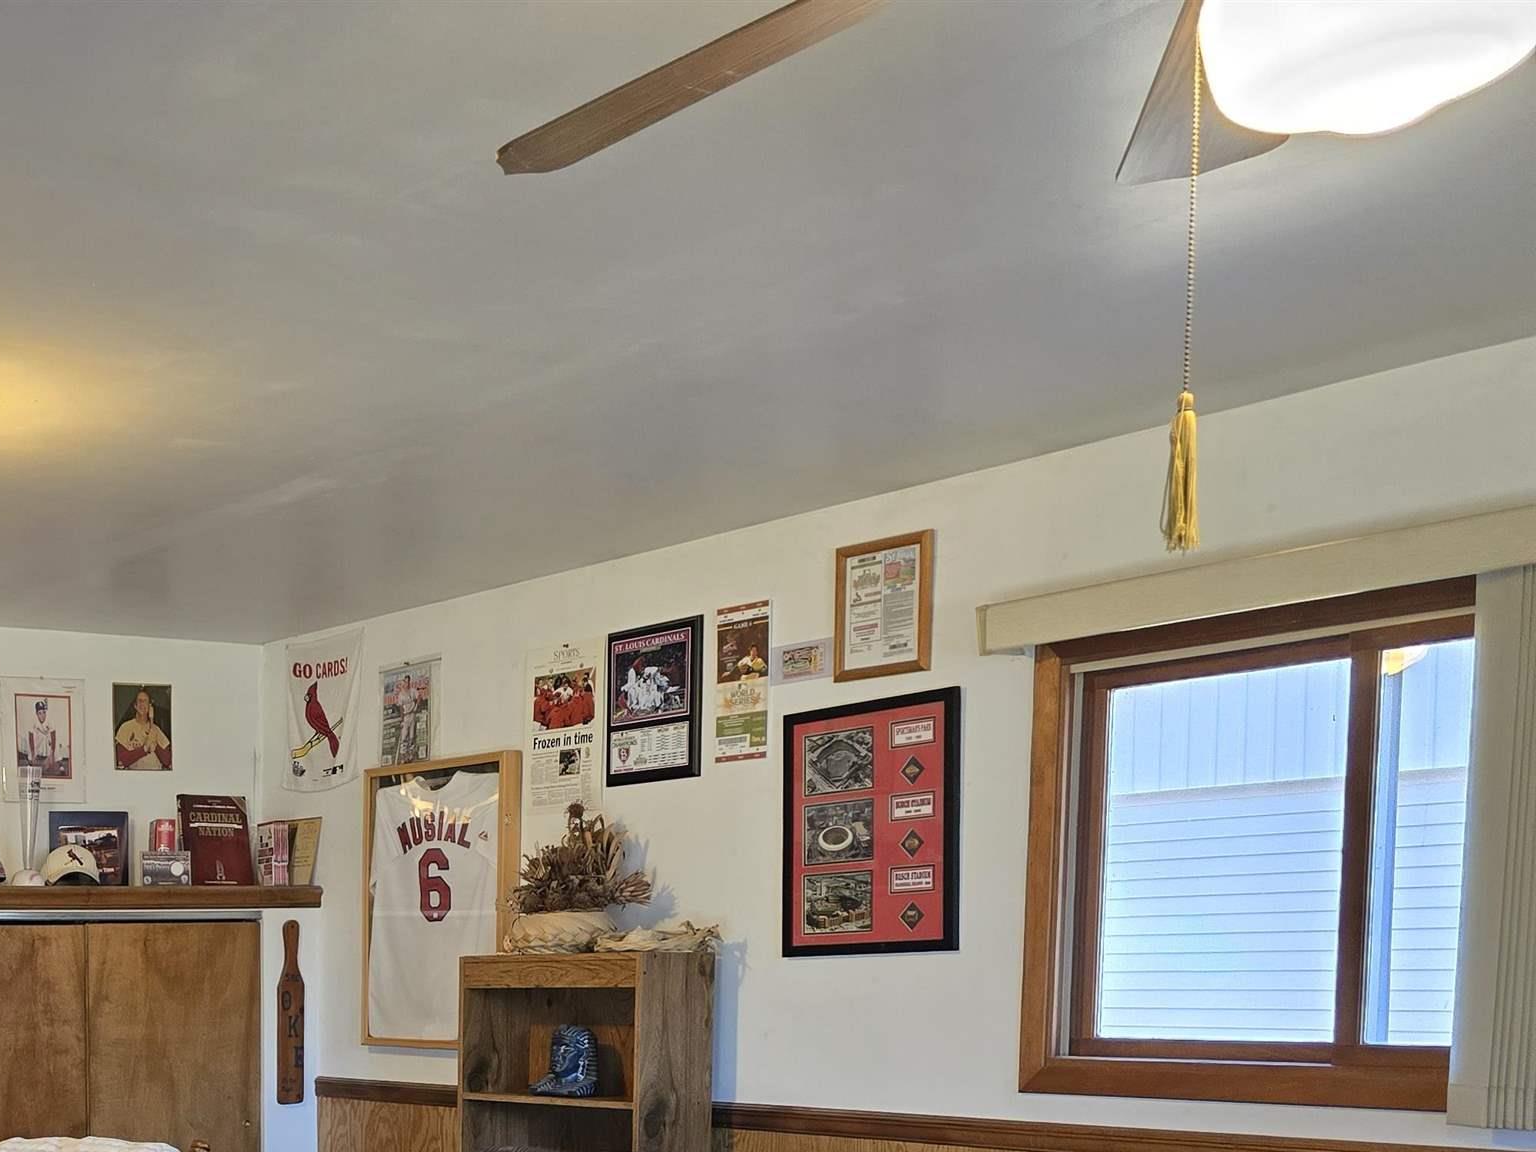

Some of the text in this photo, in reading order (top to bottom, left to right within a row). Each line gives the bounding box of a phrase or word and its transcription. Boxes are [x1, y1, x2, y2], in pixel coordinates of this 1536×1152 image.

[625, 638, 646, 650] LOUIS
[646, 632, 685, 648] CARDINALS
[553, 648, 581, 662] SPORTS
[292, 656, 349, 679] GO CARDS!
[533, 731, 593, 750] Frozen in time
[189, 811, 243, 824] CARDINAL
[198, 826, 235, 838] NATION
[396, 810, 472, 854] MUSIAL
[419, 848, 452, 922] 6
